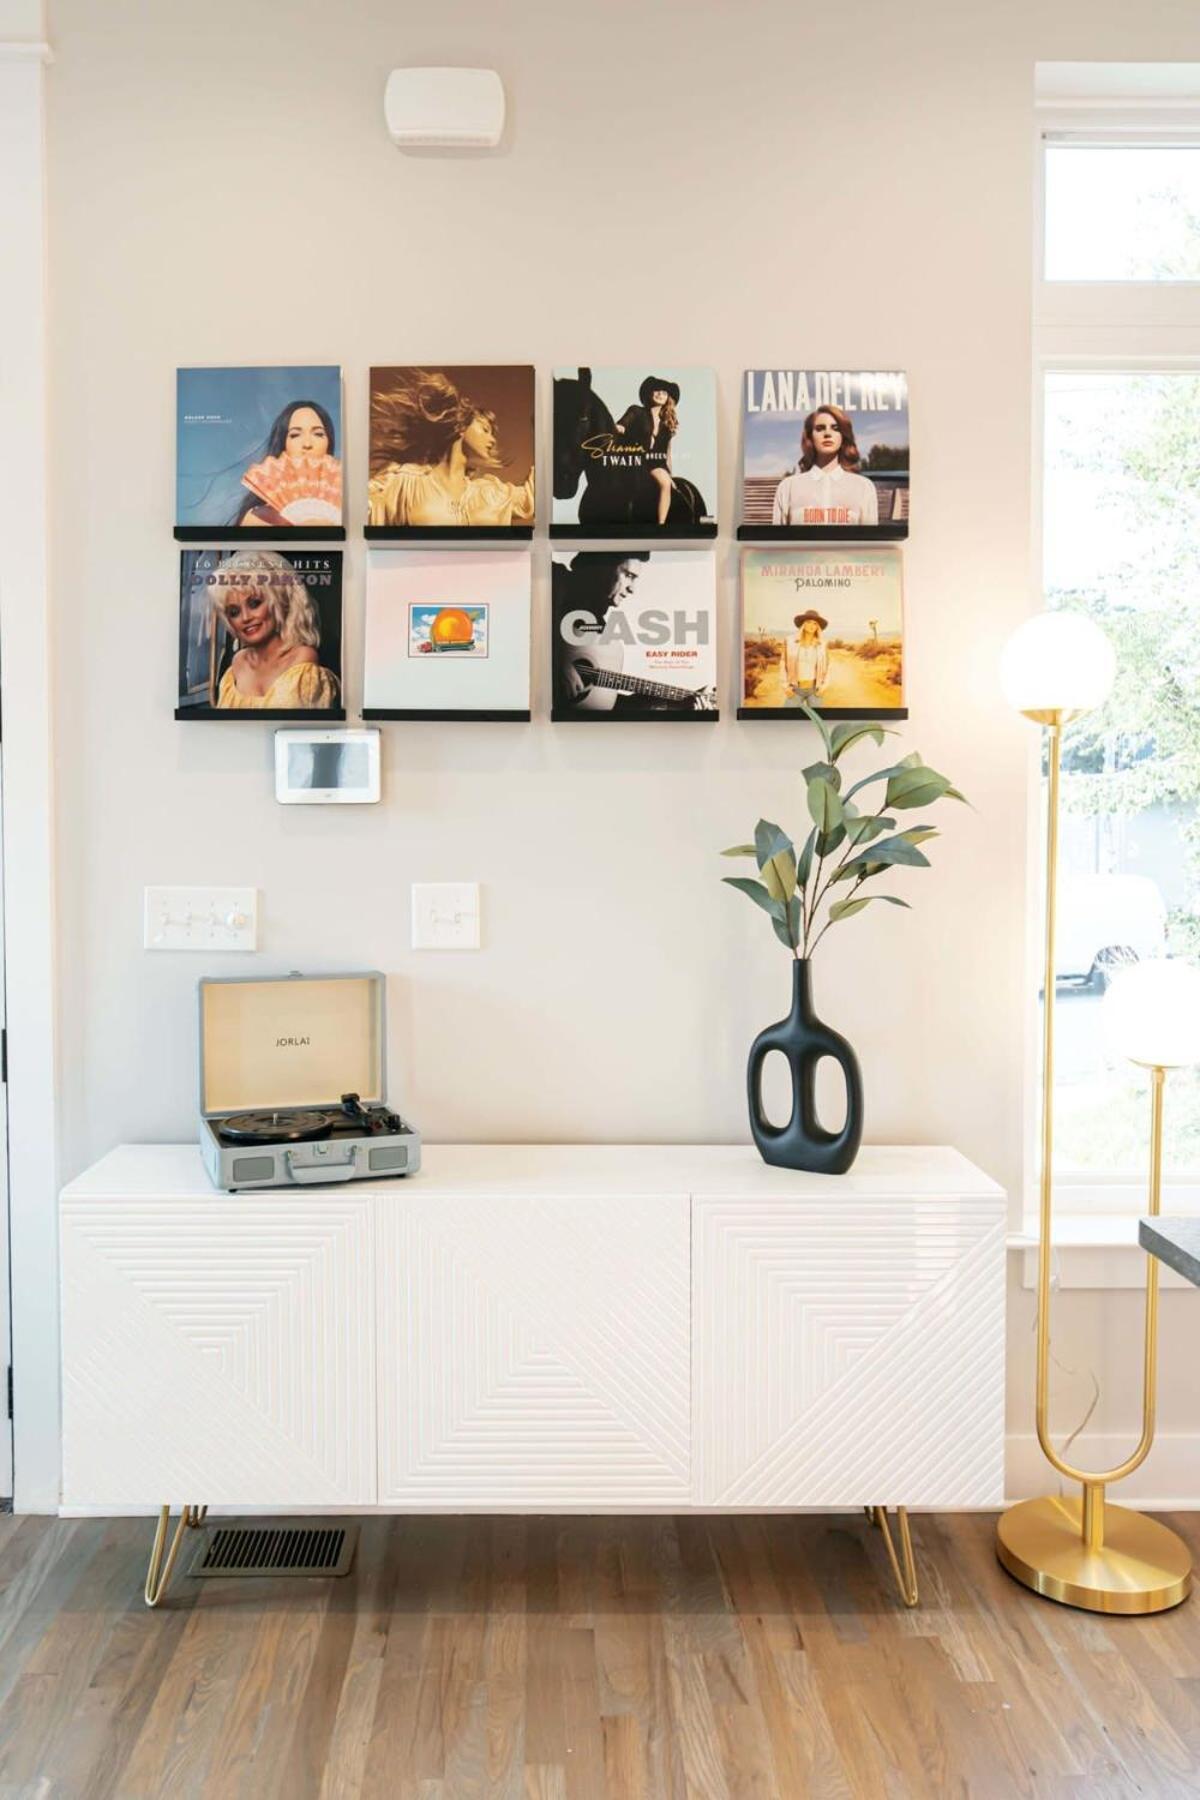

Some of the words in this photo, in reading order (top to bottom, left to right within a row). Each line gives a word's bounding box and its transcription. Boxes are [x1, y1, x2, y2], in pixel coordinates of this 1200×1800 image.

[747, 371, 811, 412] LANA
[815, 371, 857, 411] DEL
[861, 371, 906, 411] REY
[580, 433, 646, 459] Shania
[602, 455, 642, 467] TWAIN
[194, 560, 212, 569] 16
[293, 560, 331, 569] HITS
[761, 564, 822, 577] MIRANDA
[825, 564, 886, 577] LAMBERT
[190, 574, 252, 586] DOLLY
[256, 574, 332, 586] PARTON
[794, 577, 852, 592] PALOMINO
[560, 609, 709, 647] CASH
[645, 650, 669, 658] EASY
[670, 650, 698, 658] RIDER
[275, 1036, 310, 1047] JORLAI
